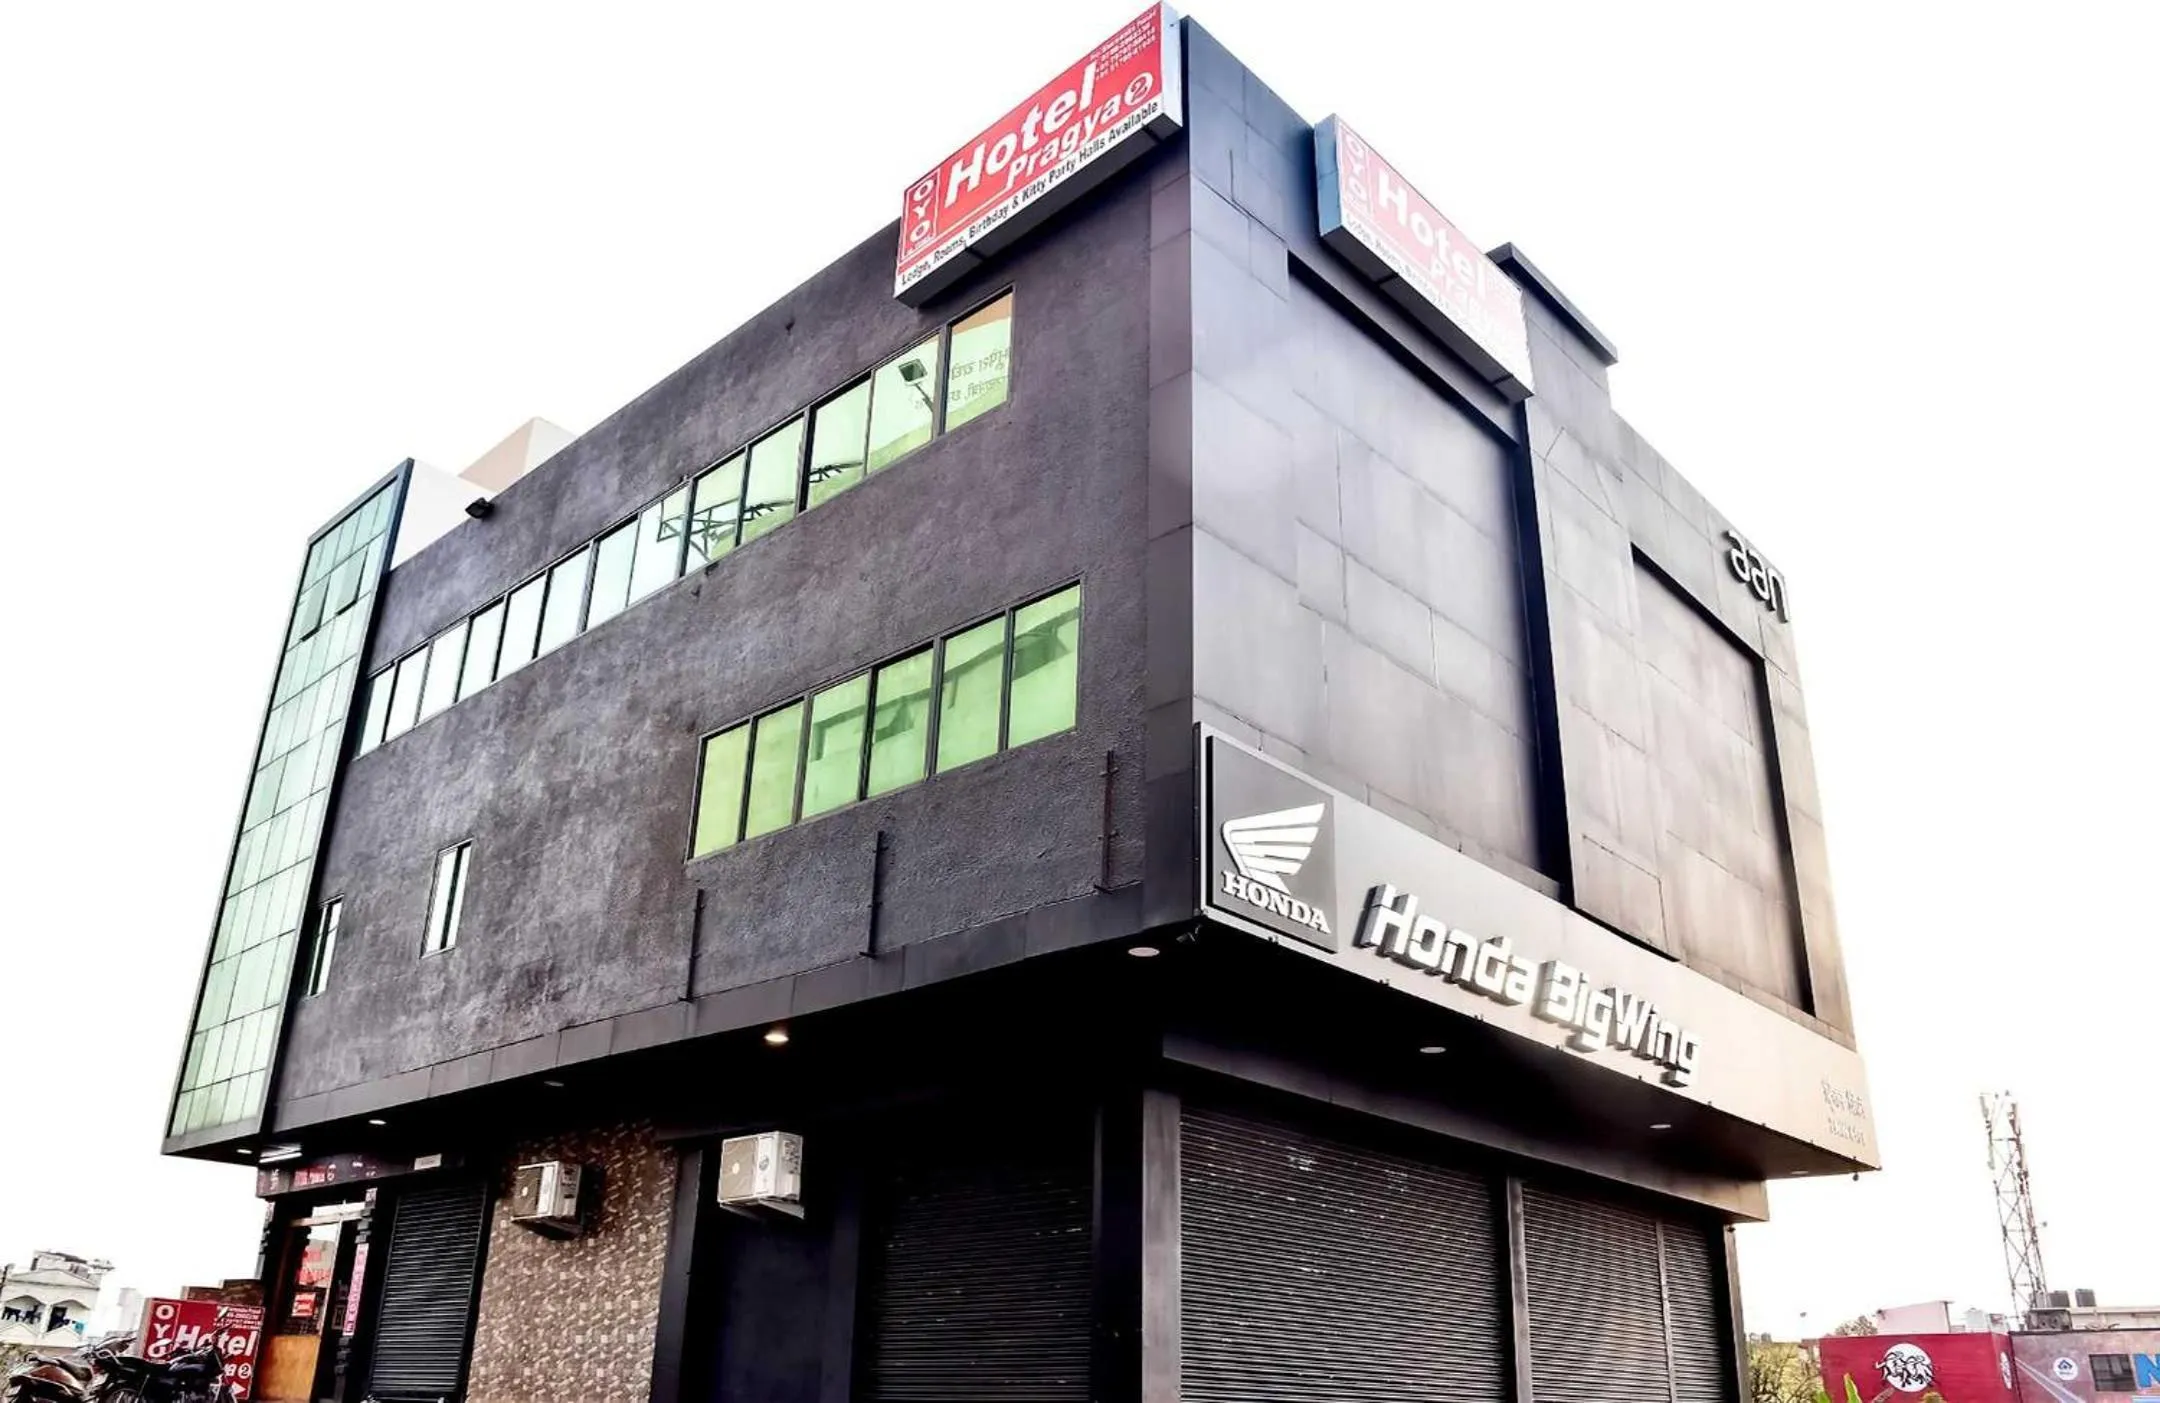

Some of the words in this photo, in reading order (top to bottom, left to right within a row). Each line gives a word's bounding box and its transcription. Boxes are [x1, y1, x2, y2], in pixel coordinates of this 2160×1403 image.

[944, 61, 1097, 208] Hotel
[969, 206, 1009, 239] Birthday
[1012, 195, 1019, 210] &
[1021, 179, 1047, 203] Kitty
[1048, 158, 1076, 185] Party
[1080, 137, 1106, 163] Halls
[1108, 100, 1159, 143] Available
[1005, 94, 1121, 190] Pragya
[1127, 75, 1151, 102] 2
[910, 180, 934, 243] OYO
[1377, 167, 1488, 299] Hotel
[1221, 871, 1333, 934] HONDA
[1364, 882, 1536, 1005] Honda
[1538, 959, 1700, 1087] BigWing
[173, 1324, 258, 1357] Hotel
